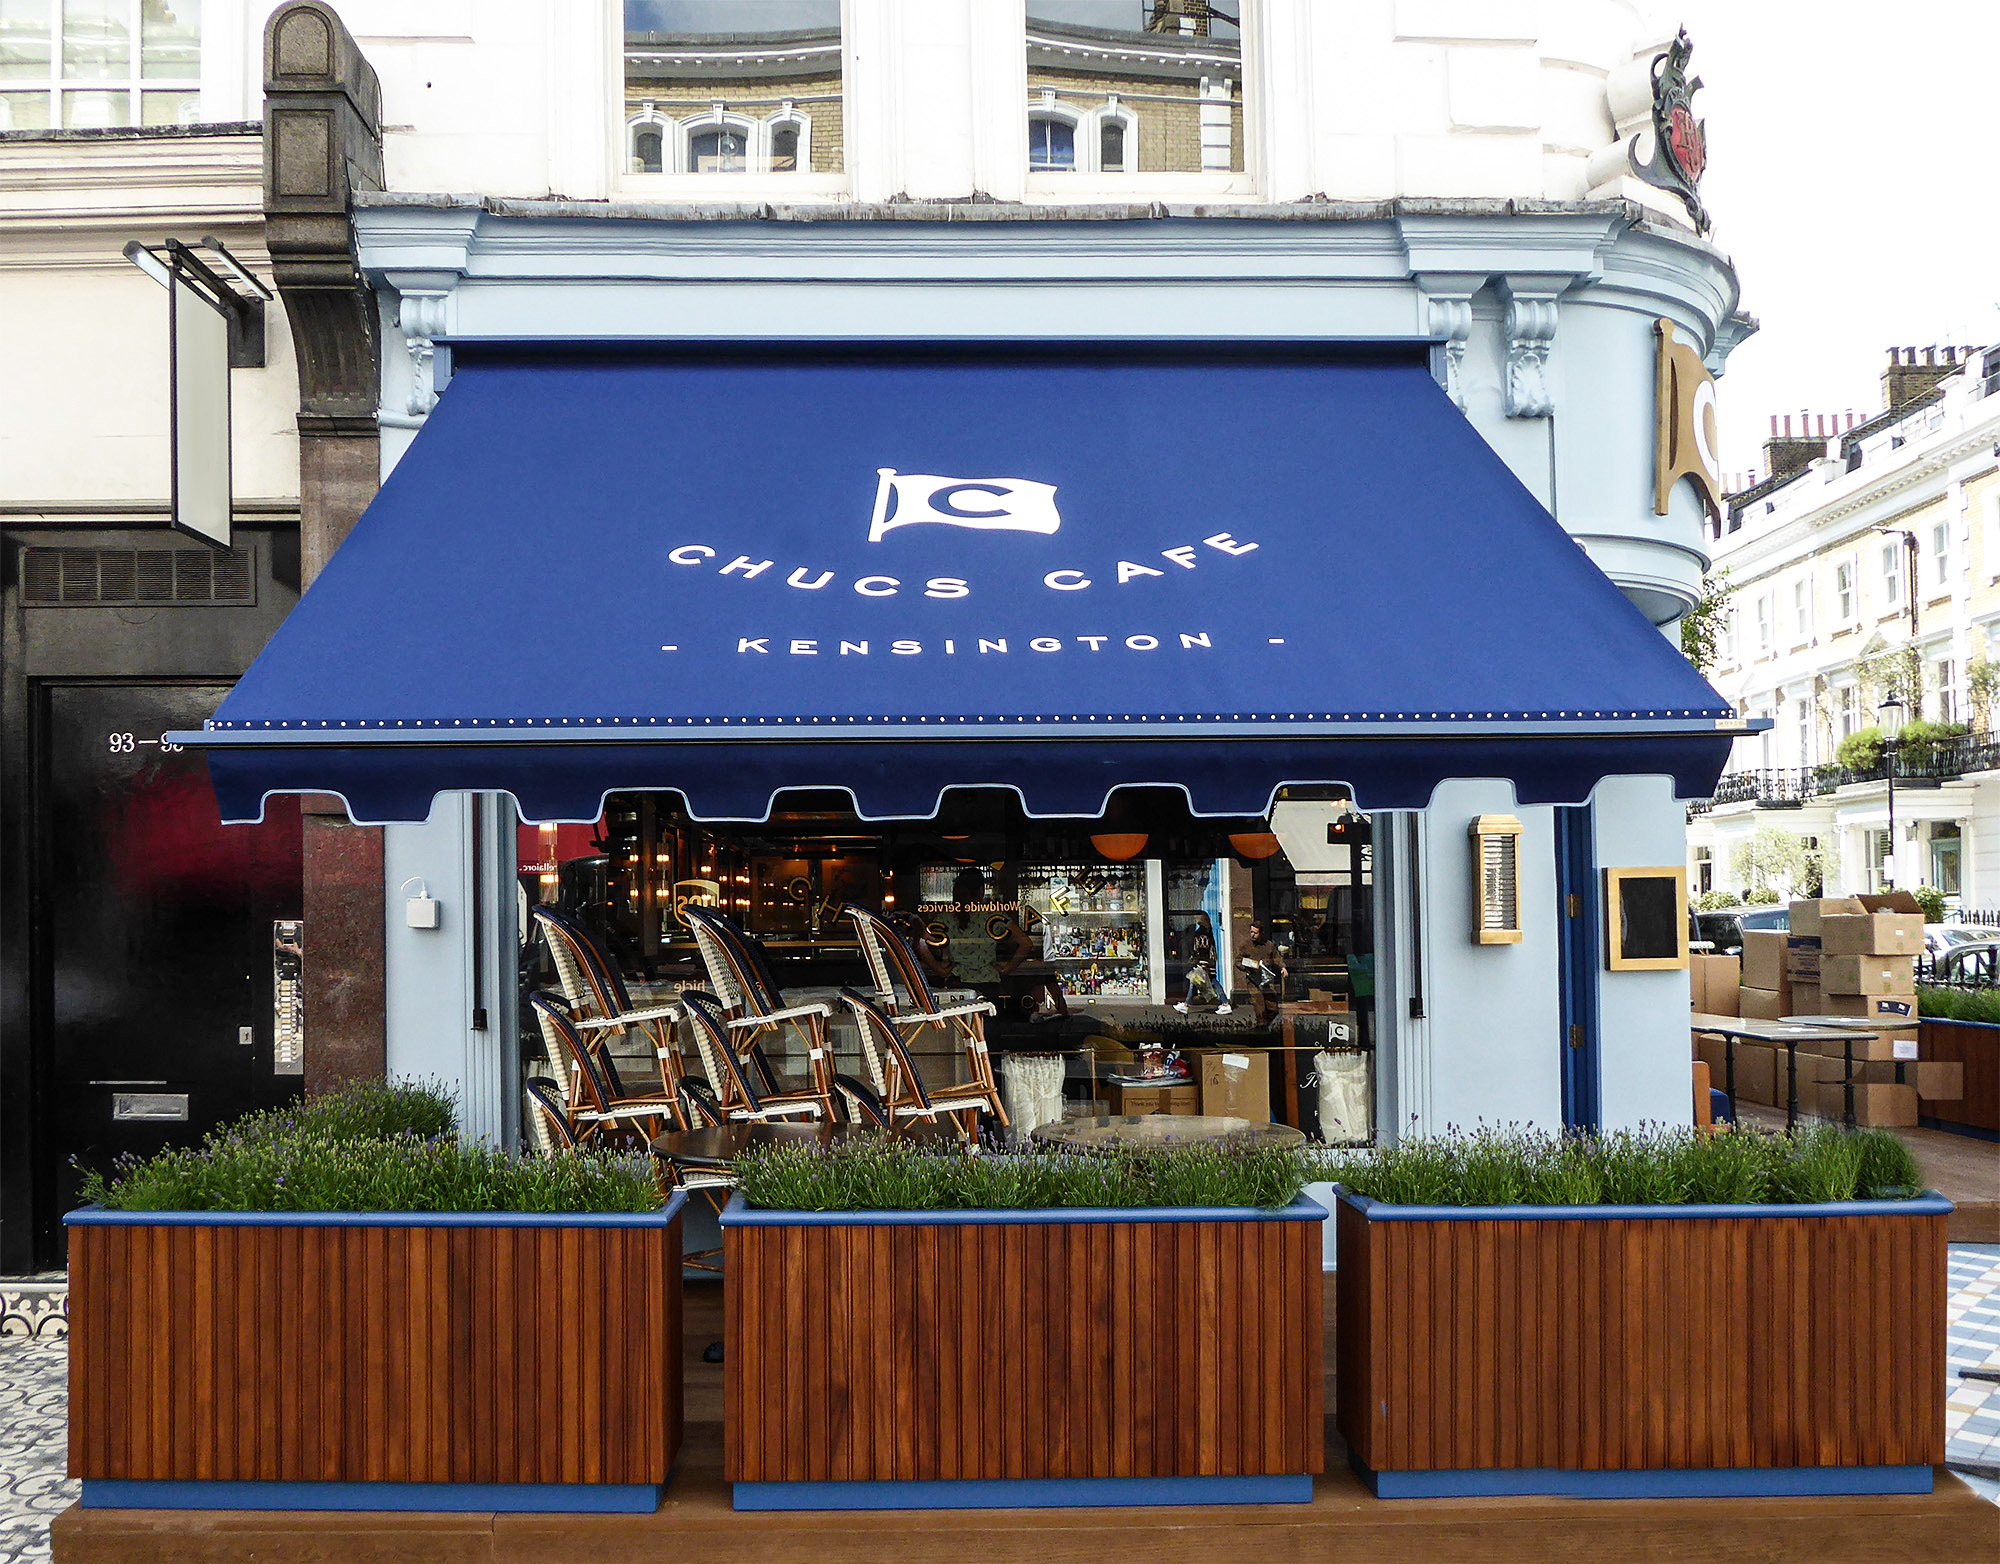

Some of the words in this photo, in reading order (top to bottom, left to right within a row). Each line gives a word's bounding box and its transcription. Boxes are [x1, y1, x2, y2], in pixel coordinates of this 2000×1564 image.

[927, 483, 1014, 519] C
[668, 545, 970, 598] CHUCS
[1043, 532, 1260, 591] CAFE
[737, 632, 1212, 656] KENSINGTON
[984, 866, 1105, 940] CAFE
